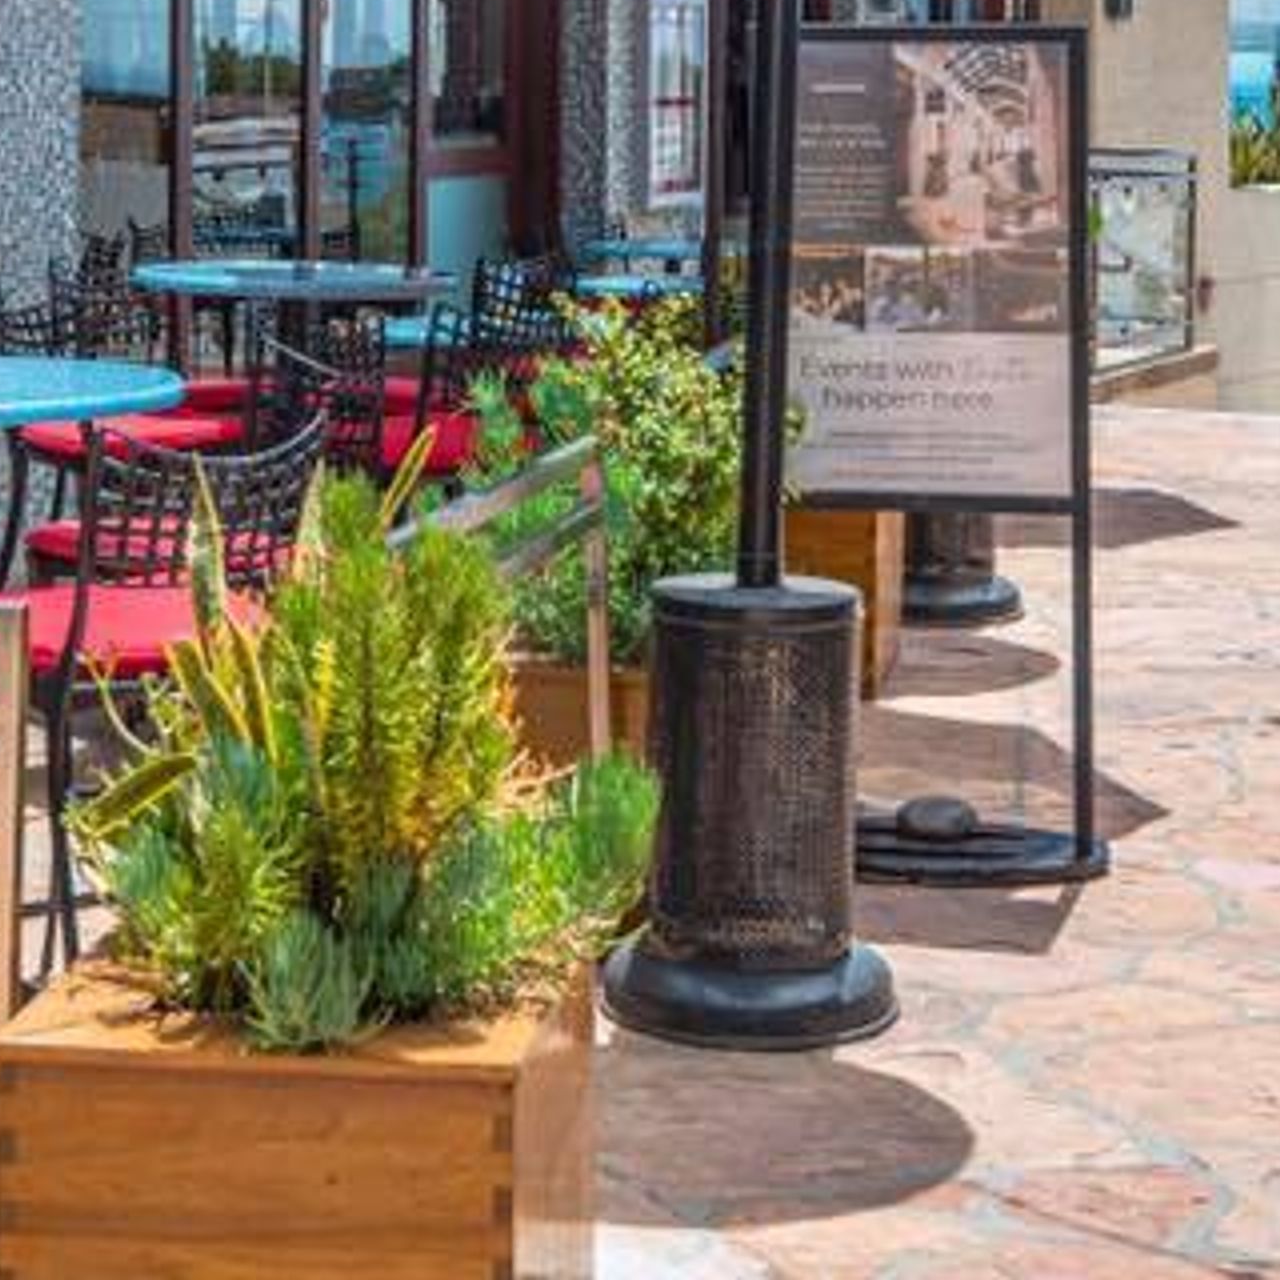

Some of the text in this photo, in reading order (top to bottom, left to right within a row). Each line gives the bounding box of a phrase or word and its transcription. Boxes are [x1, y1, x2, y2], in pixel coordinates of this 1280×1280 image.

[799, 355, 888, 382] Events
[895, 358, 955, 382] with
[822, 384, 929, 417] happen
